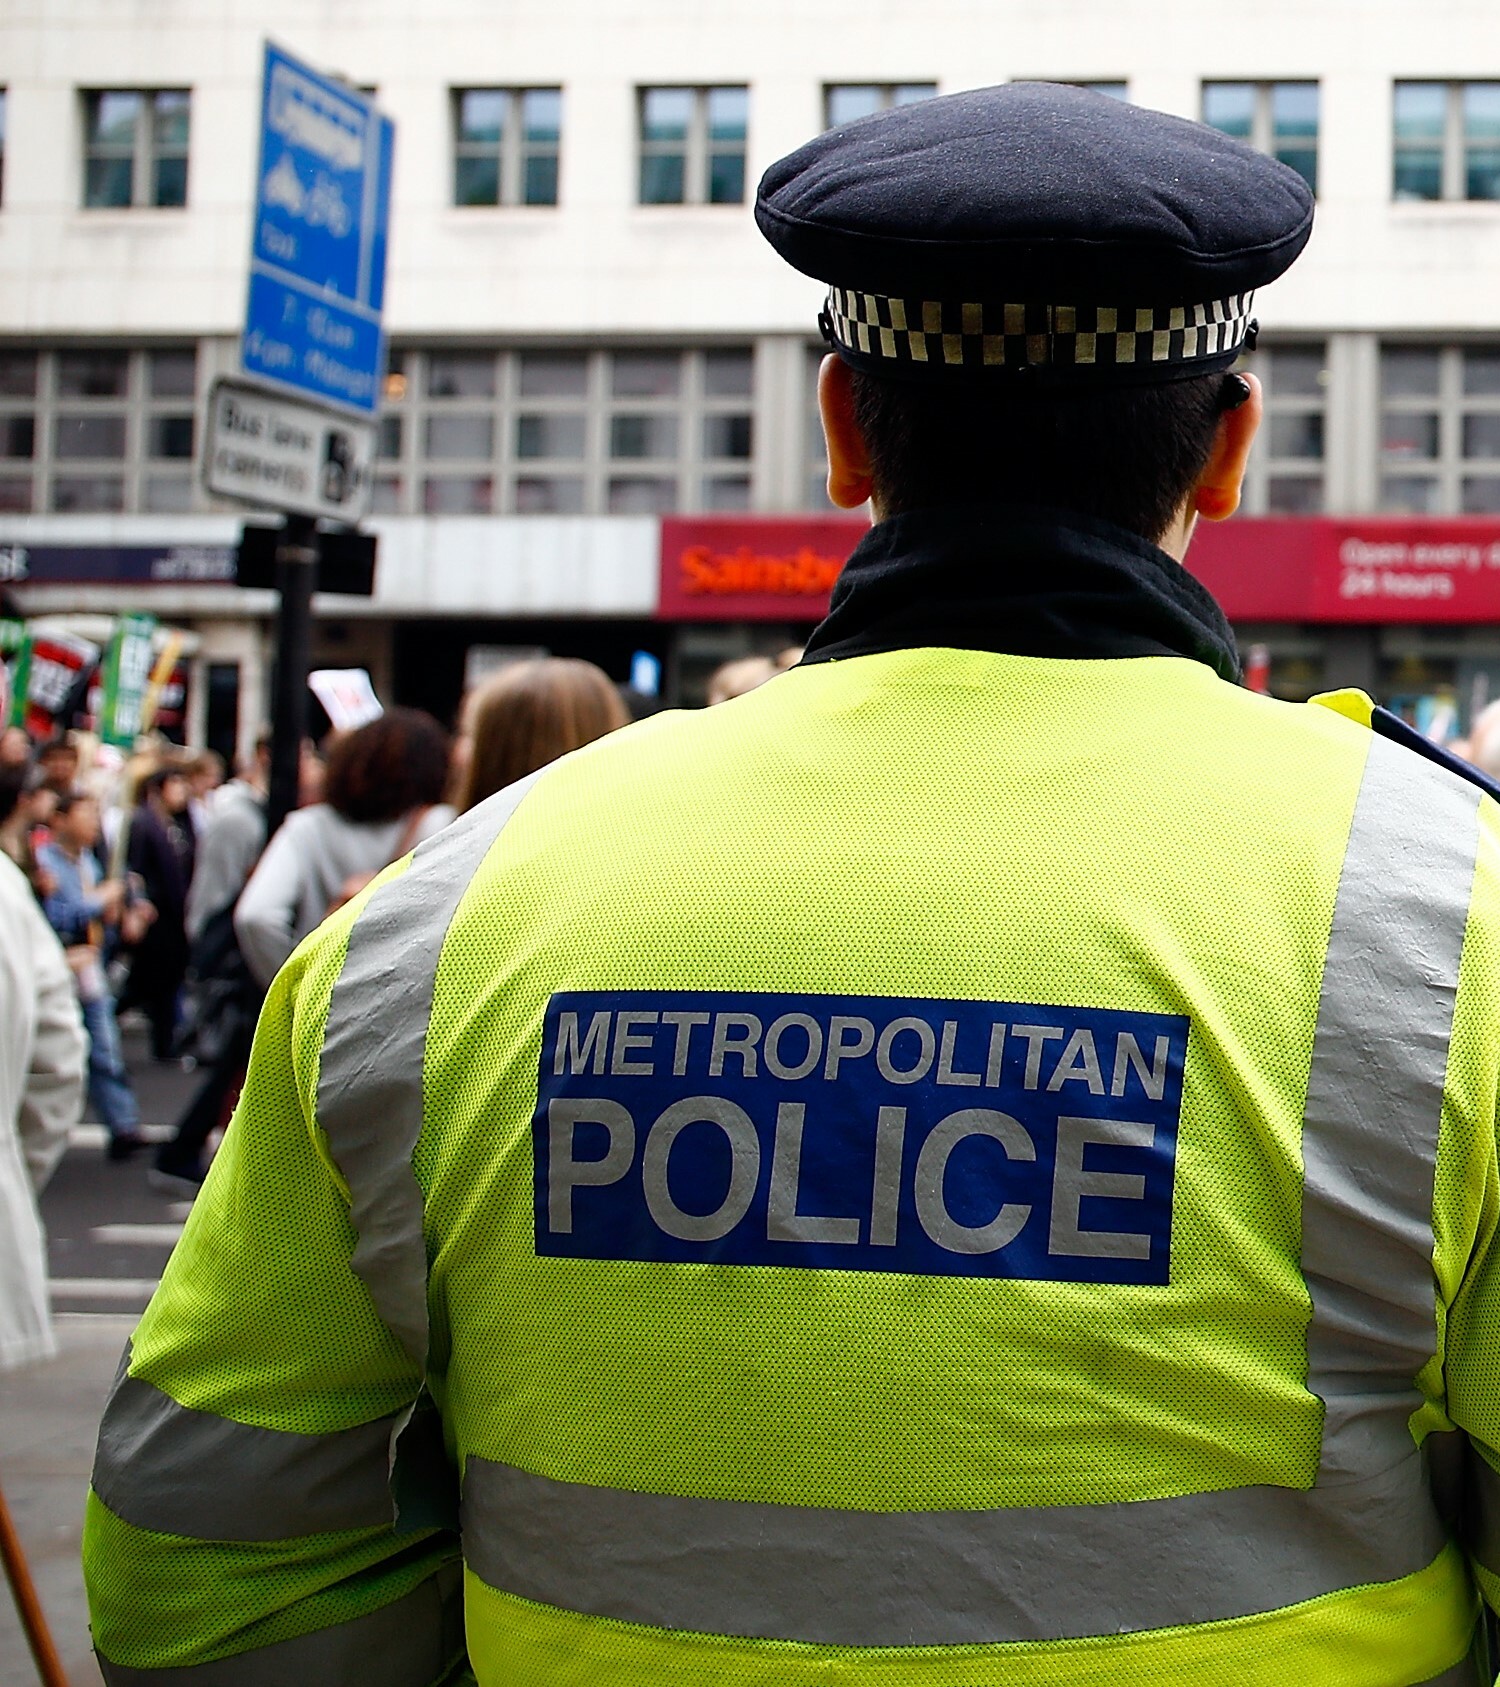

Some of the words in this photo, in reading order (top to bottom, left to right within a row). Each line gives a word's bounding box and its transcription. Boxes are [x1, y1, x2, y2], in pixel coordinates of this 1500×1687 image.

[222, 400, 263, 437] Bus
[1340, 537, 1408, 572] Open
[1410, 543, 1481, 574] every
[1340, 567, 1376, 598] 24
[1382, 570, 1455, 599] hours
[552, 1011, 1170, 1100] METROPOLITAN
[548, 1095, 1157, 1259] POLICE
